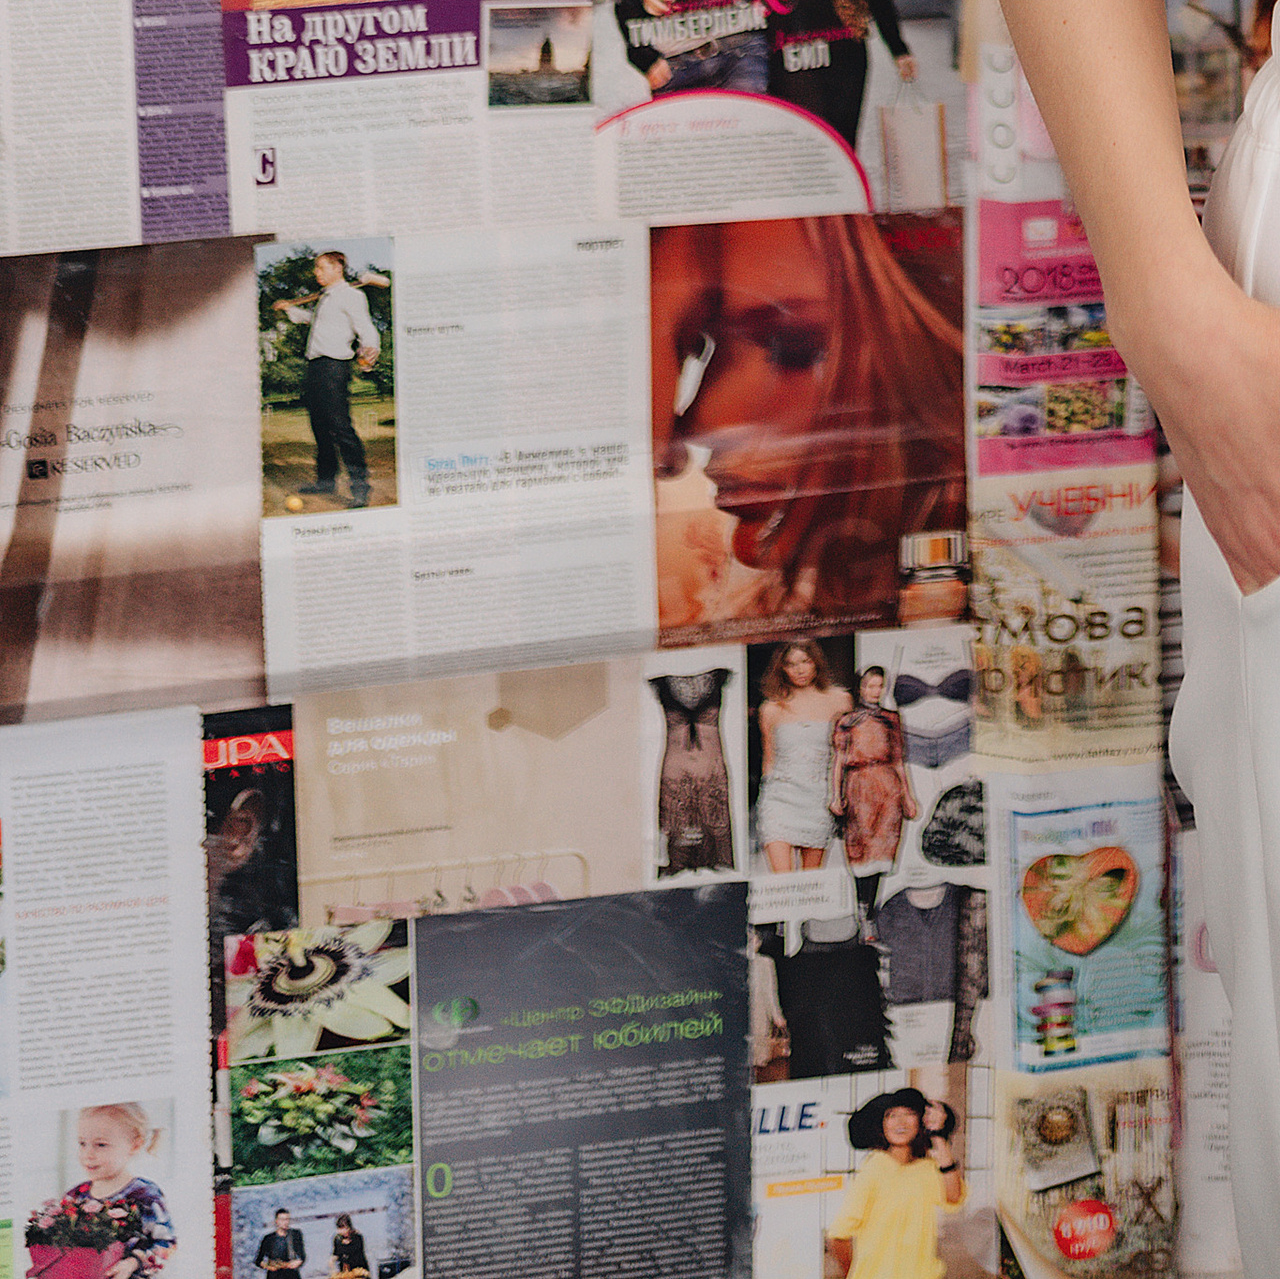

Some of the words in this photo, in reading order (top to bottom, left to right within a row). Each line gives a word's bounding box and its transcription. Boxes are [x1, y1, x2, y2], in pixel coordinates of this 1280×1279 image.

[247, 11, 297, 44] На
[301, 3, 428, 46] другом
[625, 0, 768, 48] ТИМБЕРЛЕЙК
[248, 45, 349, 83] КРАЮ
[353, 31, 479, 74] ЗЕМЛИ
[783, 38, 832, 73] БИЛ
[1001, 263, 1077, 293] 2018
[1003, 356, 1053, 376] March
[51, 453, 142, 477] RESERVED
[326, 712, 423, 735] Вешалки
[326, 740, 368, 759] для
[370, 728, 458, 751] одежды
[422, 1033, 585, 1073] отмечает
[593, 1010, 724, 1051] юбилей
